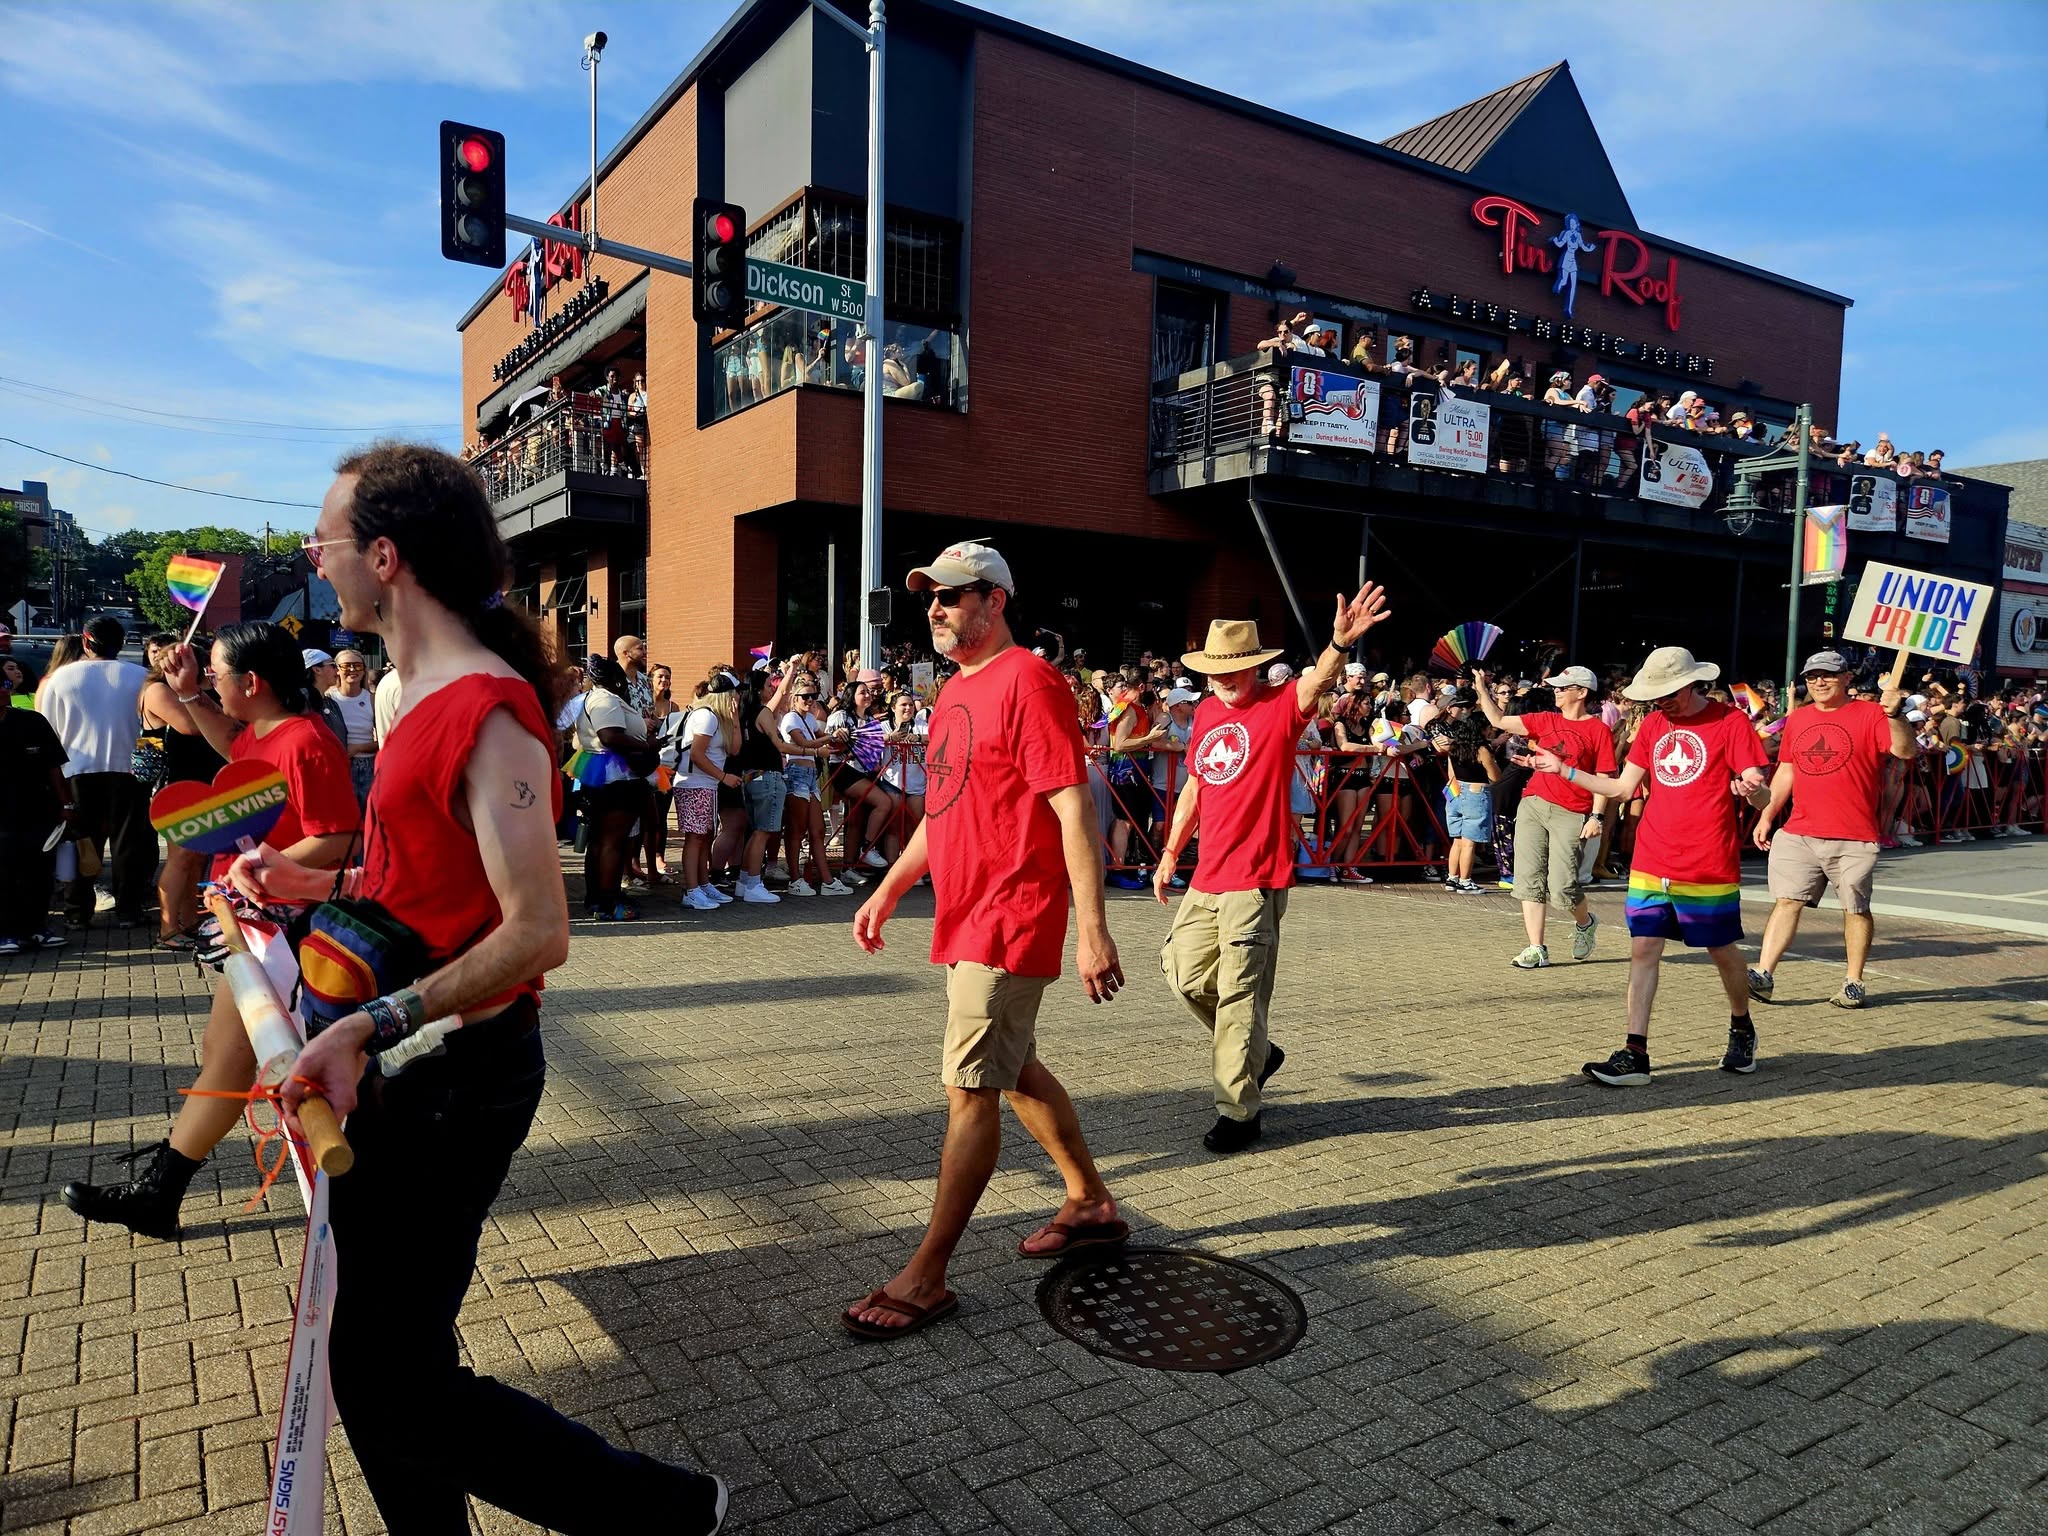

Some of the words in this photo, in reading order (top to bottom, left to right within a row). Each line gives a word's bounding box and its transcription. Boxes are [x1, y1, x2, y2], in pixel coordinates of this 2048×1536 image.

[747, 265, 824, 306] Dickson
[840, 283, 851, 298] St
[1471, 196, 1552, 274] Tin
[1598, 230, 1681, 332] Roof
[831, 297, 840, 312] W
[842, 301, 863, 317] 500
[1418, 289, 1431, 307] A
[1453, 295, 1518, 330] LIVE
[1536, 319, 1625, 356] MUSIC
[1640, 343, 1715, 376] JOINT
[1418, 433, 1430, 441] FIFA
[1443, 413, 1476, 428] ULTRA
[1061, 597, 1078, 608] 430
[1877, 571, 1978, 621] UNION
[1865, 604, 1967, 657] PRIDE
[166, 809, 230, 842] LOVE
[229, 786, 286, 816] WINS
[272, 1460, 295, 1536] ASTSIGNS
